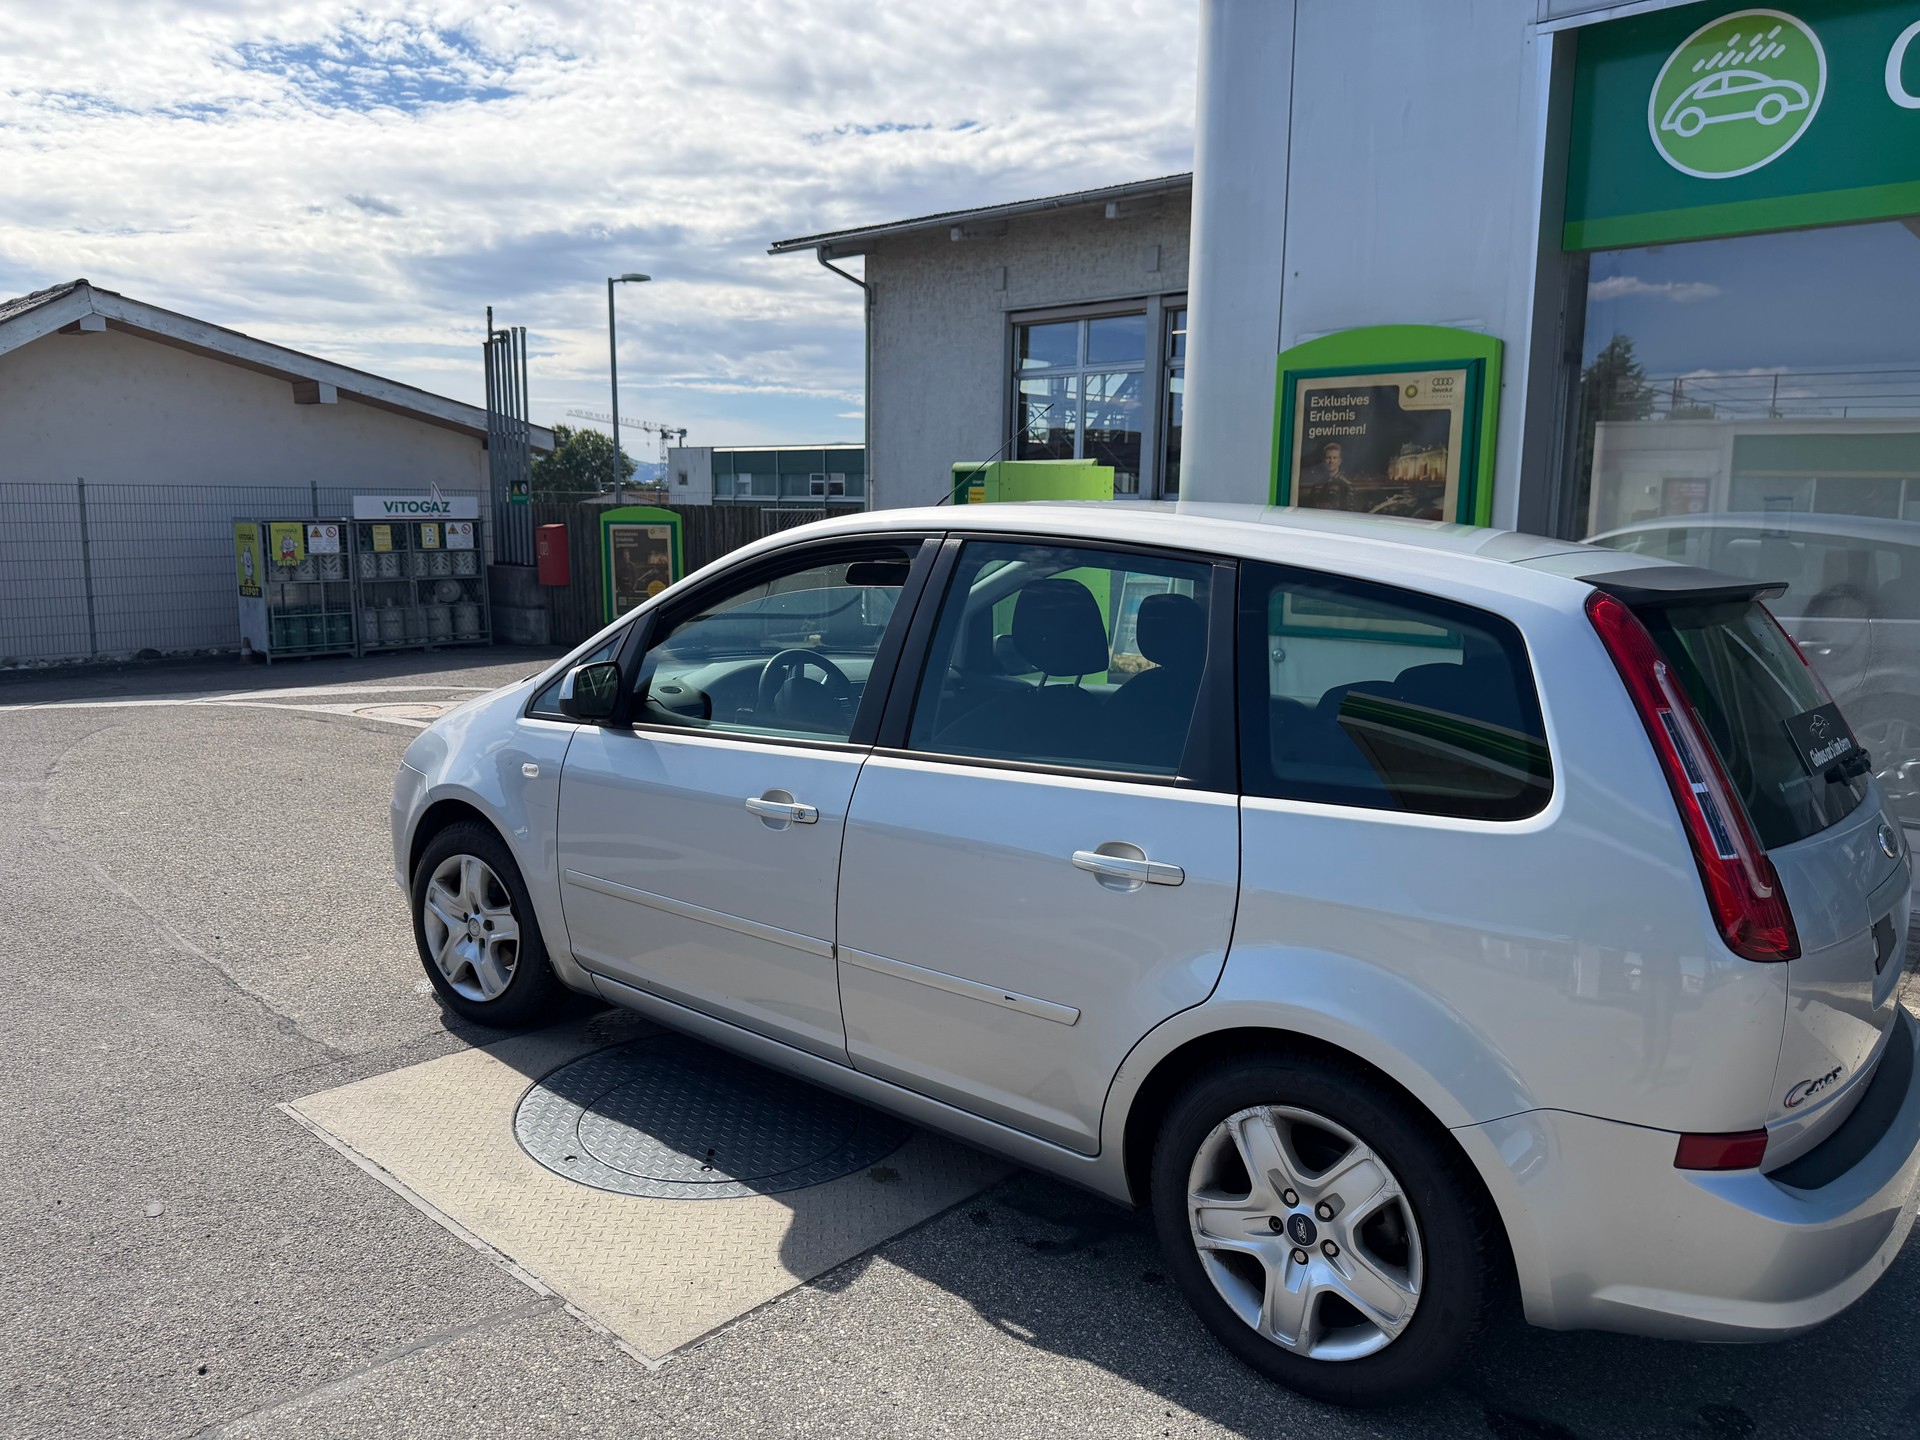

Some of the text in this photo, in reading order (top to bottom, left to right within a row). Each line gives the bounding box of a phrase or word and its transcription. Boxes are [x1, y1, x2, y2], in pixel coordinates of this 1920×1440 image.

[1310, 394, 1370, 407] Exklusives
[1309, 408, 1356, 422] Erlebnis
[1308, 424, 1367, 439] gewinnen!
